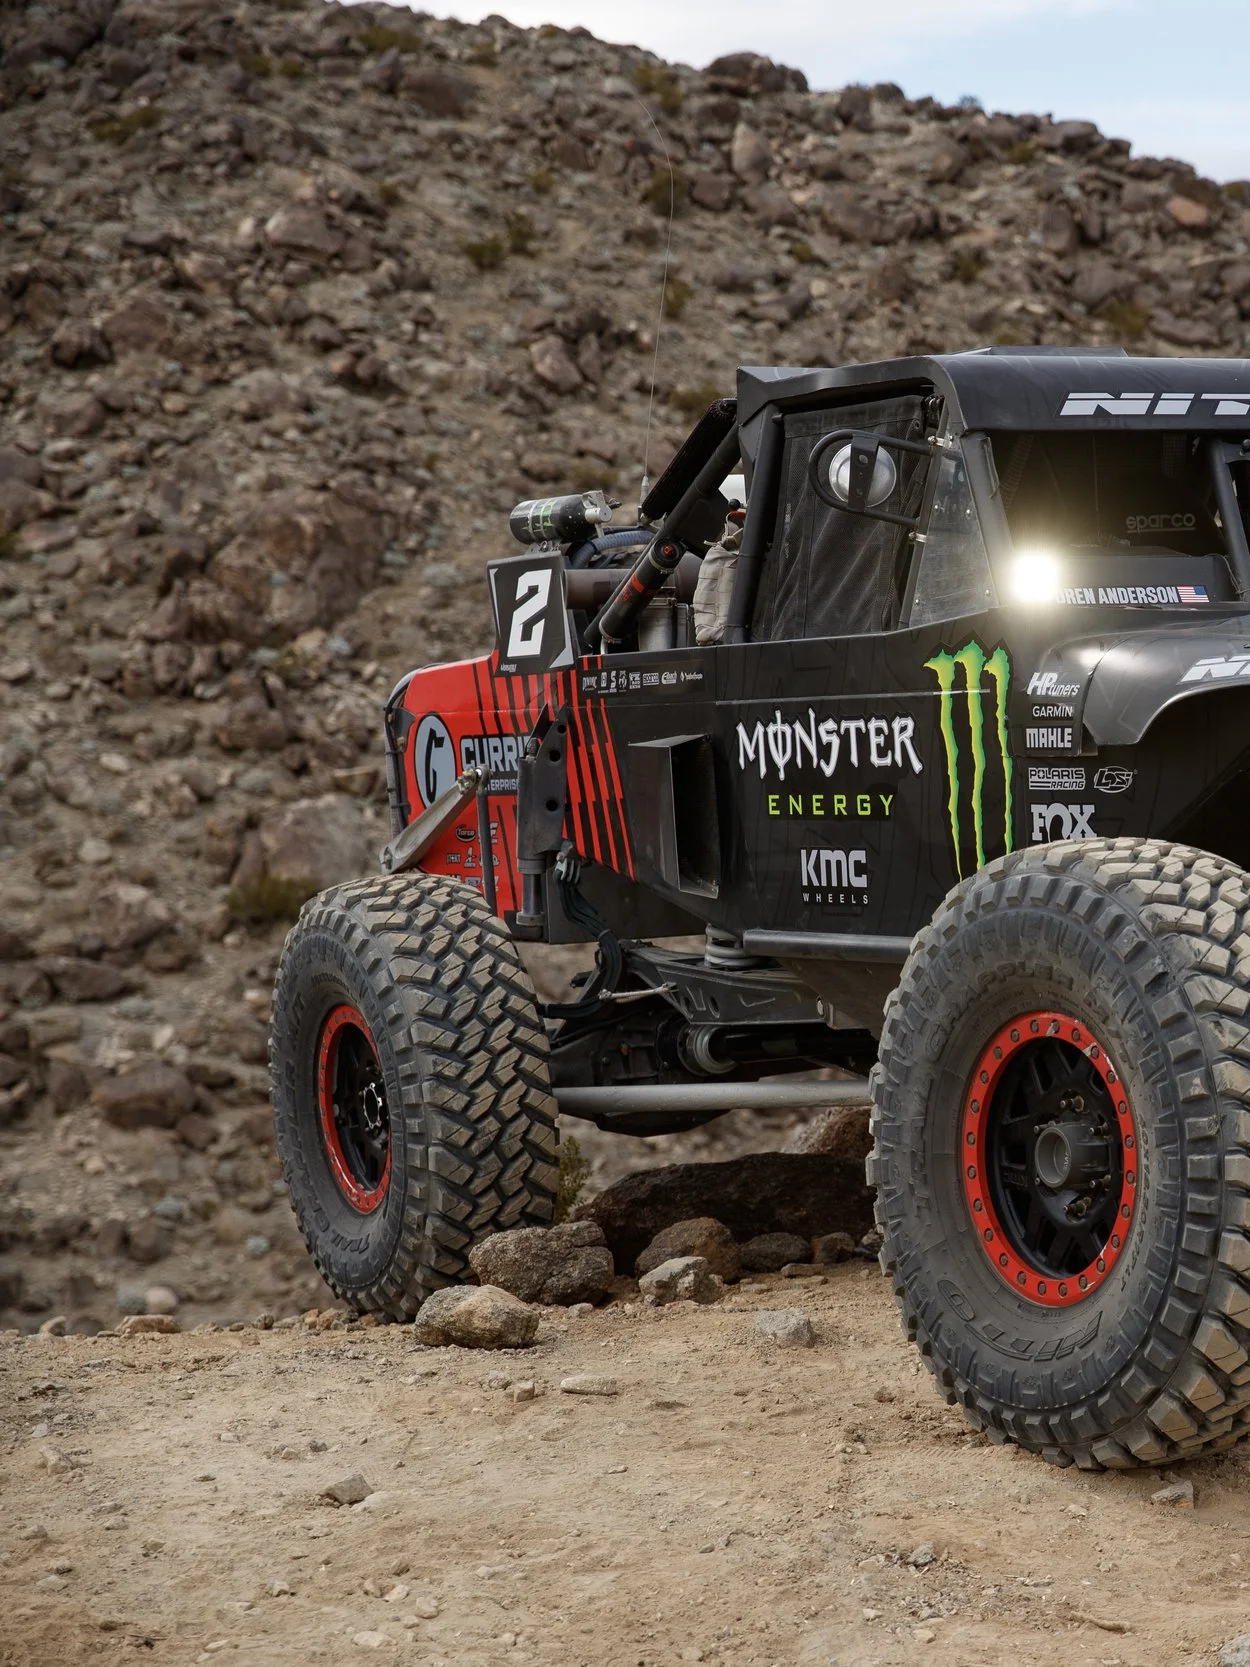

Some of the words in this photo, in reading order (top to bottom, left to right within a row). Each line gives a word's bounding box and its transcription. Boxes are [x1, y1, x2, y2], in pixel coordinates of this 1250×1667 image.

[1126, 513, 1196, 534] sparco
[1098, 586, 1179, 604] ANDERSON
[507, 569, 552, 658] 2
[1033, 705, 1073, 717] GARMIN
[735, 707, 924, 781] MONSTER
[1026, 728, 1072, 748] MAHLE
[460, 736, 532, 773] CURRI
[1029, 768, 1085, 780] POLARIS
[1050, 780, 1085, 790] RACING
[767, 794, 894, 816] ENERGY
[1031, 802, 1097, 843] FOX
[800, 849, 868, 888] KMC
[802, 892, 869, 905] WHEELS
